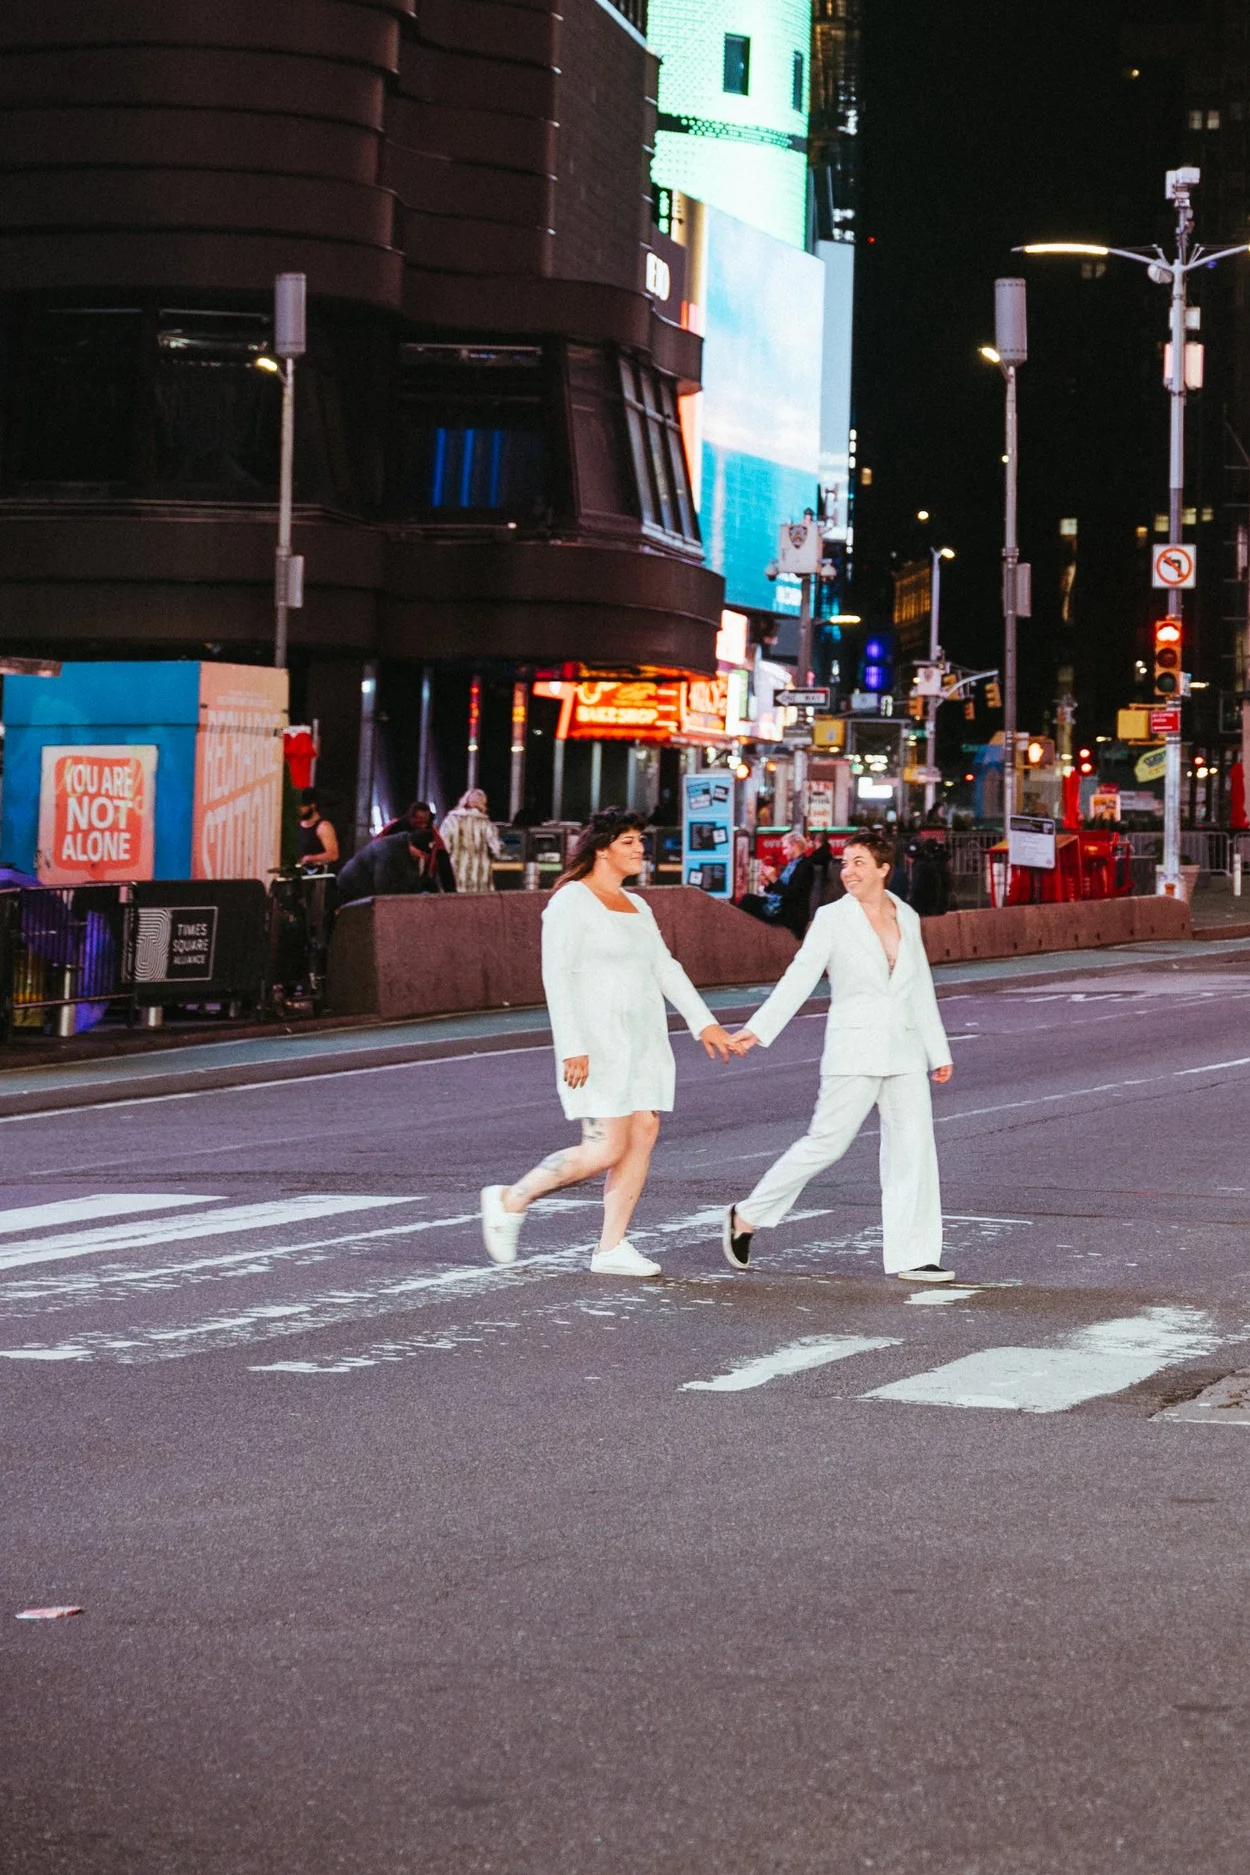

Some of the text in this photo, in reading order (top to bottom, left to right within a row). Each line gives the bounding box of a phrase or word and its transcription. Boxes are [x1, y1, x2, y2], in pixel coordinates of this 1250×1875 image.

[66, 764, 133, 799] YOU ARE
[67, 796, 135, 832] NOT
[62, 829, 132, 862] ALONE
[177, 923, 208, 937] TIMES
